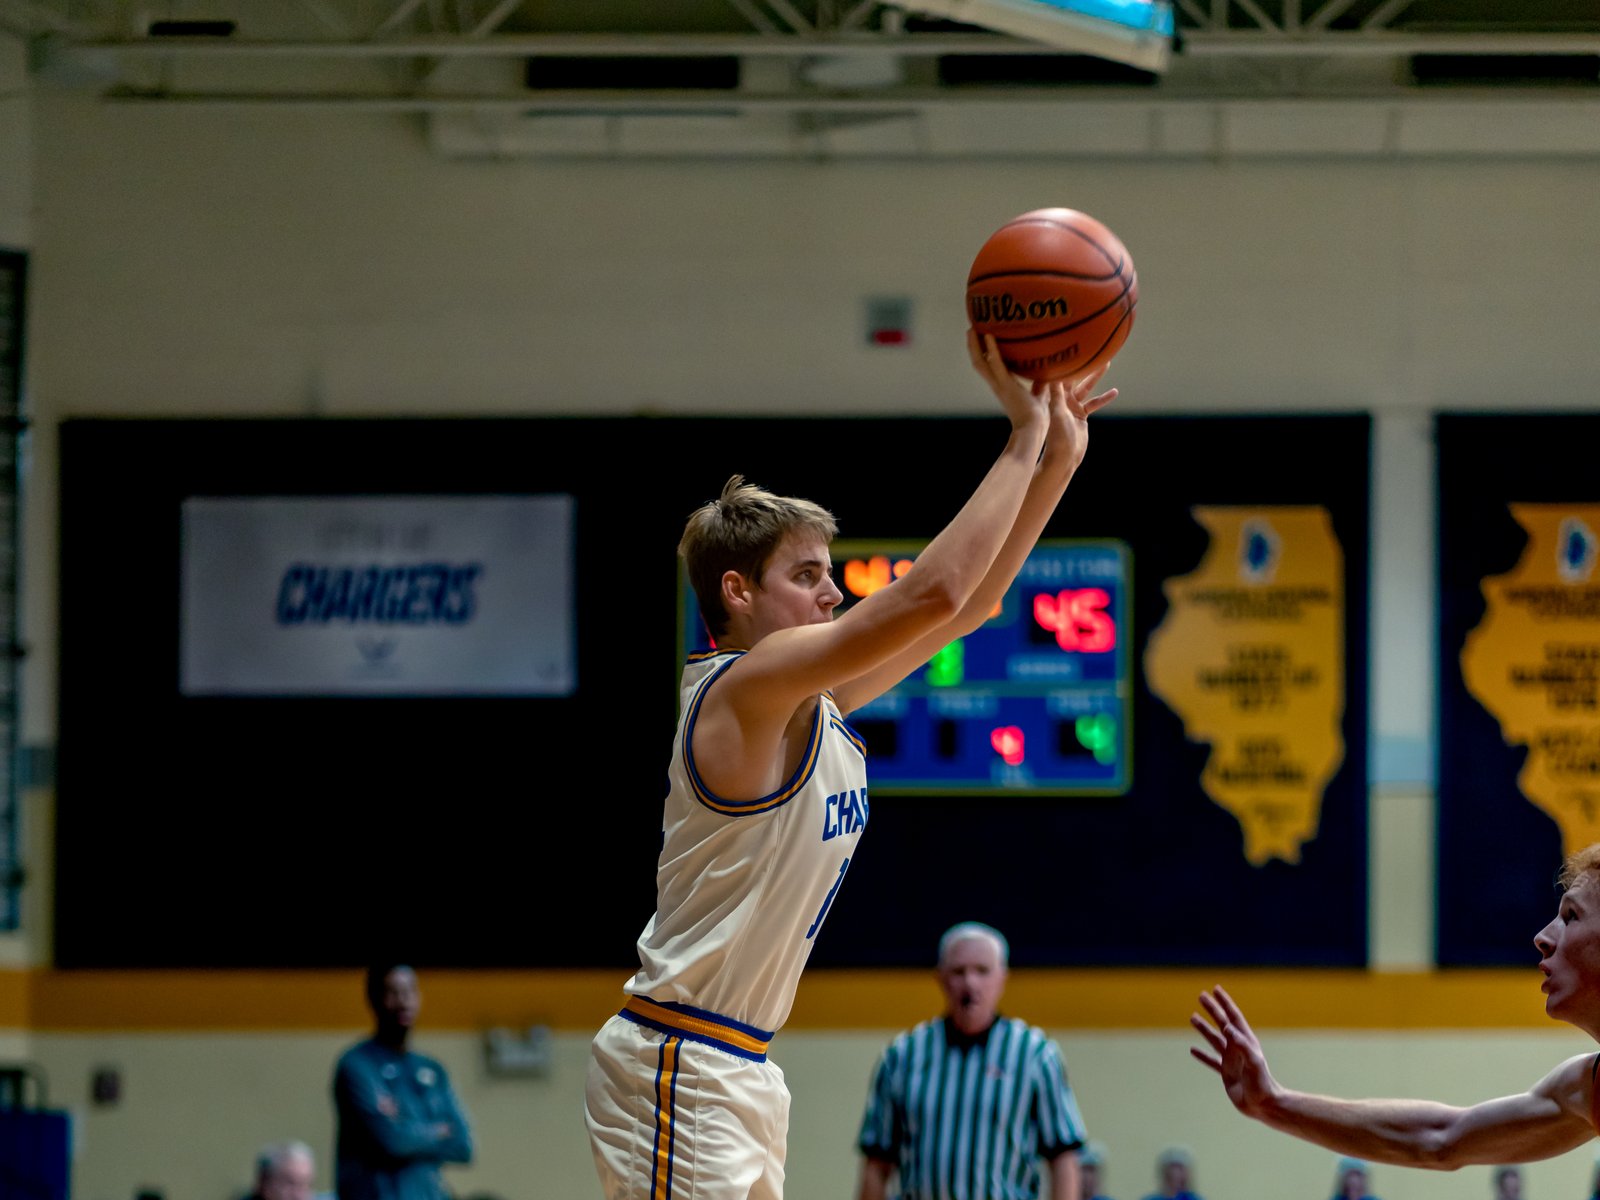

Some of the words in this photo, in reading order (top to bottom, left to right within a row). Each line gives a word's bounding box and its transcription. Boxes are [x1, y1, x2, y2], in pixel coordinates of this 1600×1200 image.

[971, 293, 1068, 323] Wilson
[276, 560, 485, 627] CHARGERS
[1033, 587, 1117, 653] 45
